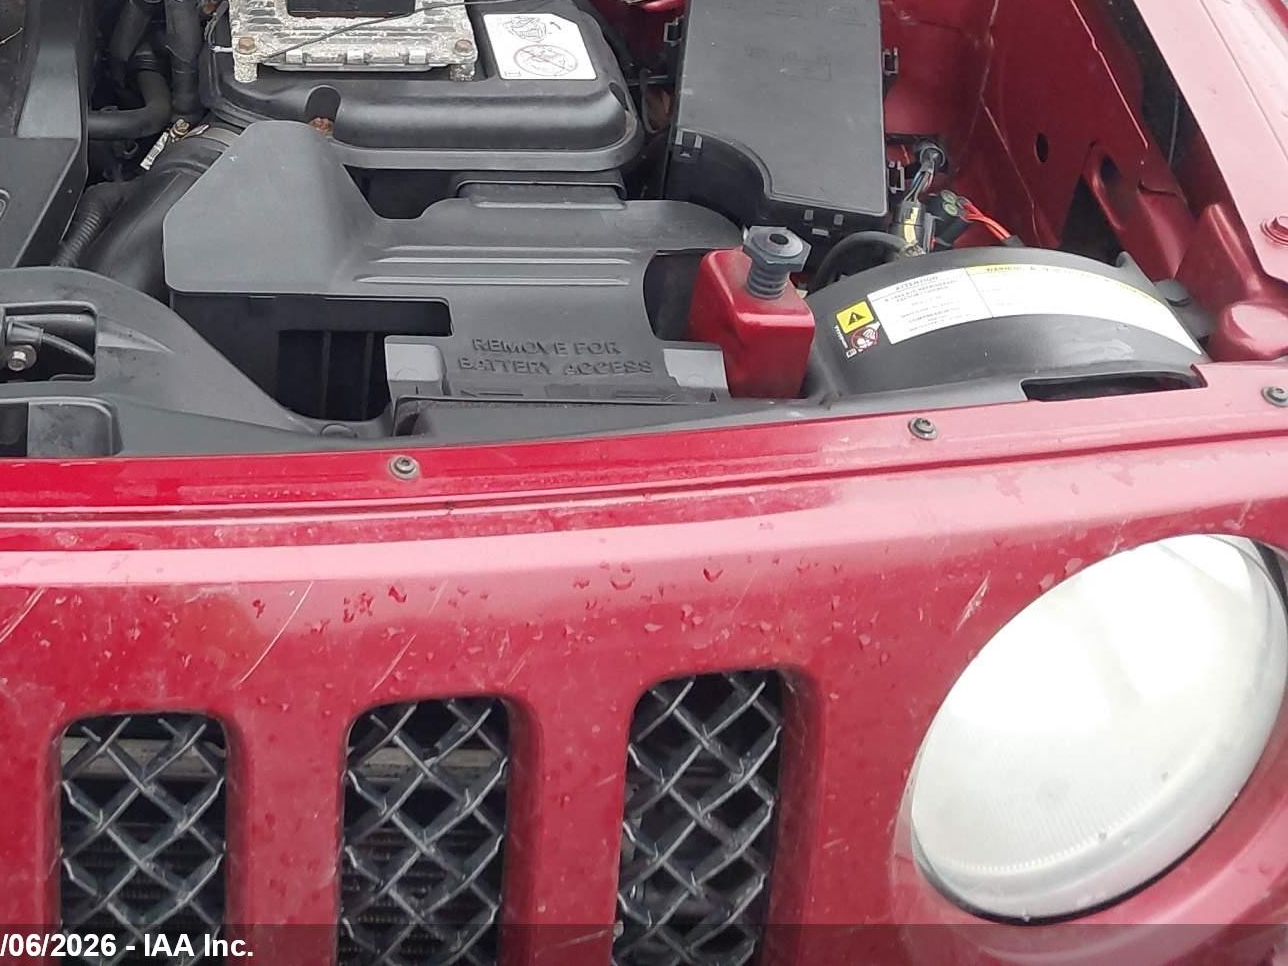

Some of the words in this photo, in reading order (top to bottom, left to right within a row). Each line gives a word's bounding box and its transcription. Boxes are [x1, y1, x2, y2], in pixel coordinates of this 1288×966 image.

[471, 338, 569, 355] REMOVE
[573, 341, 622, 355] FOR
[458, 357, 553, 375] BATTERY
[564, 360, 653, 376] ACCESS
